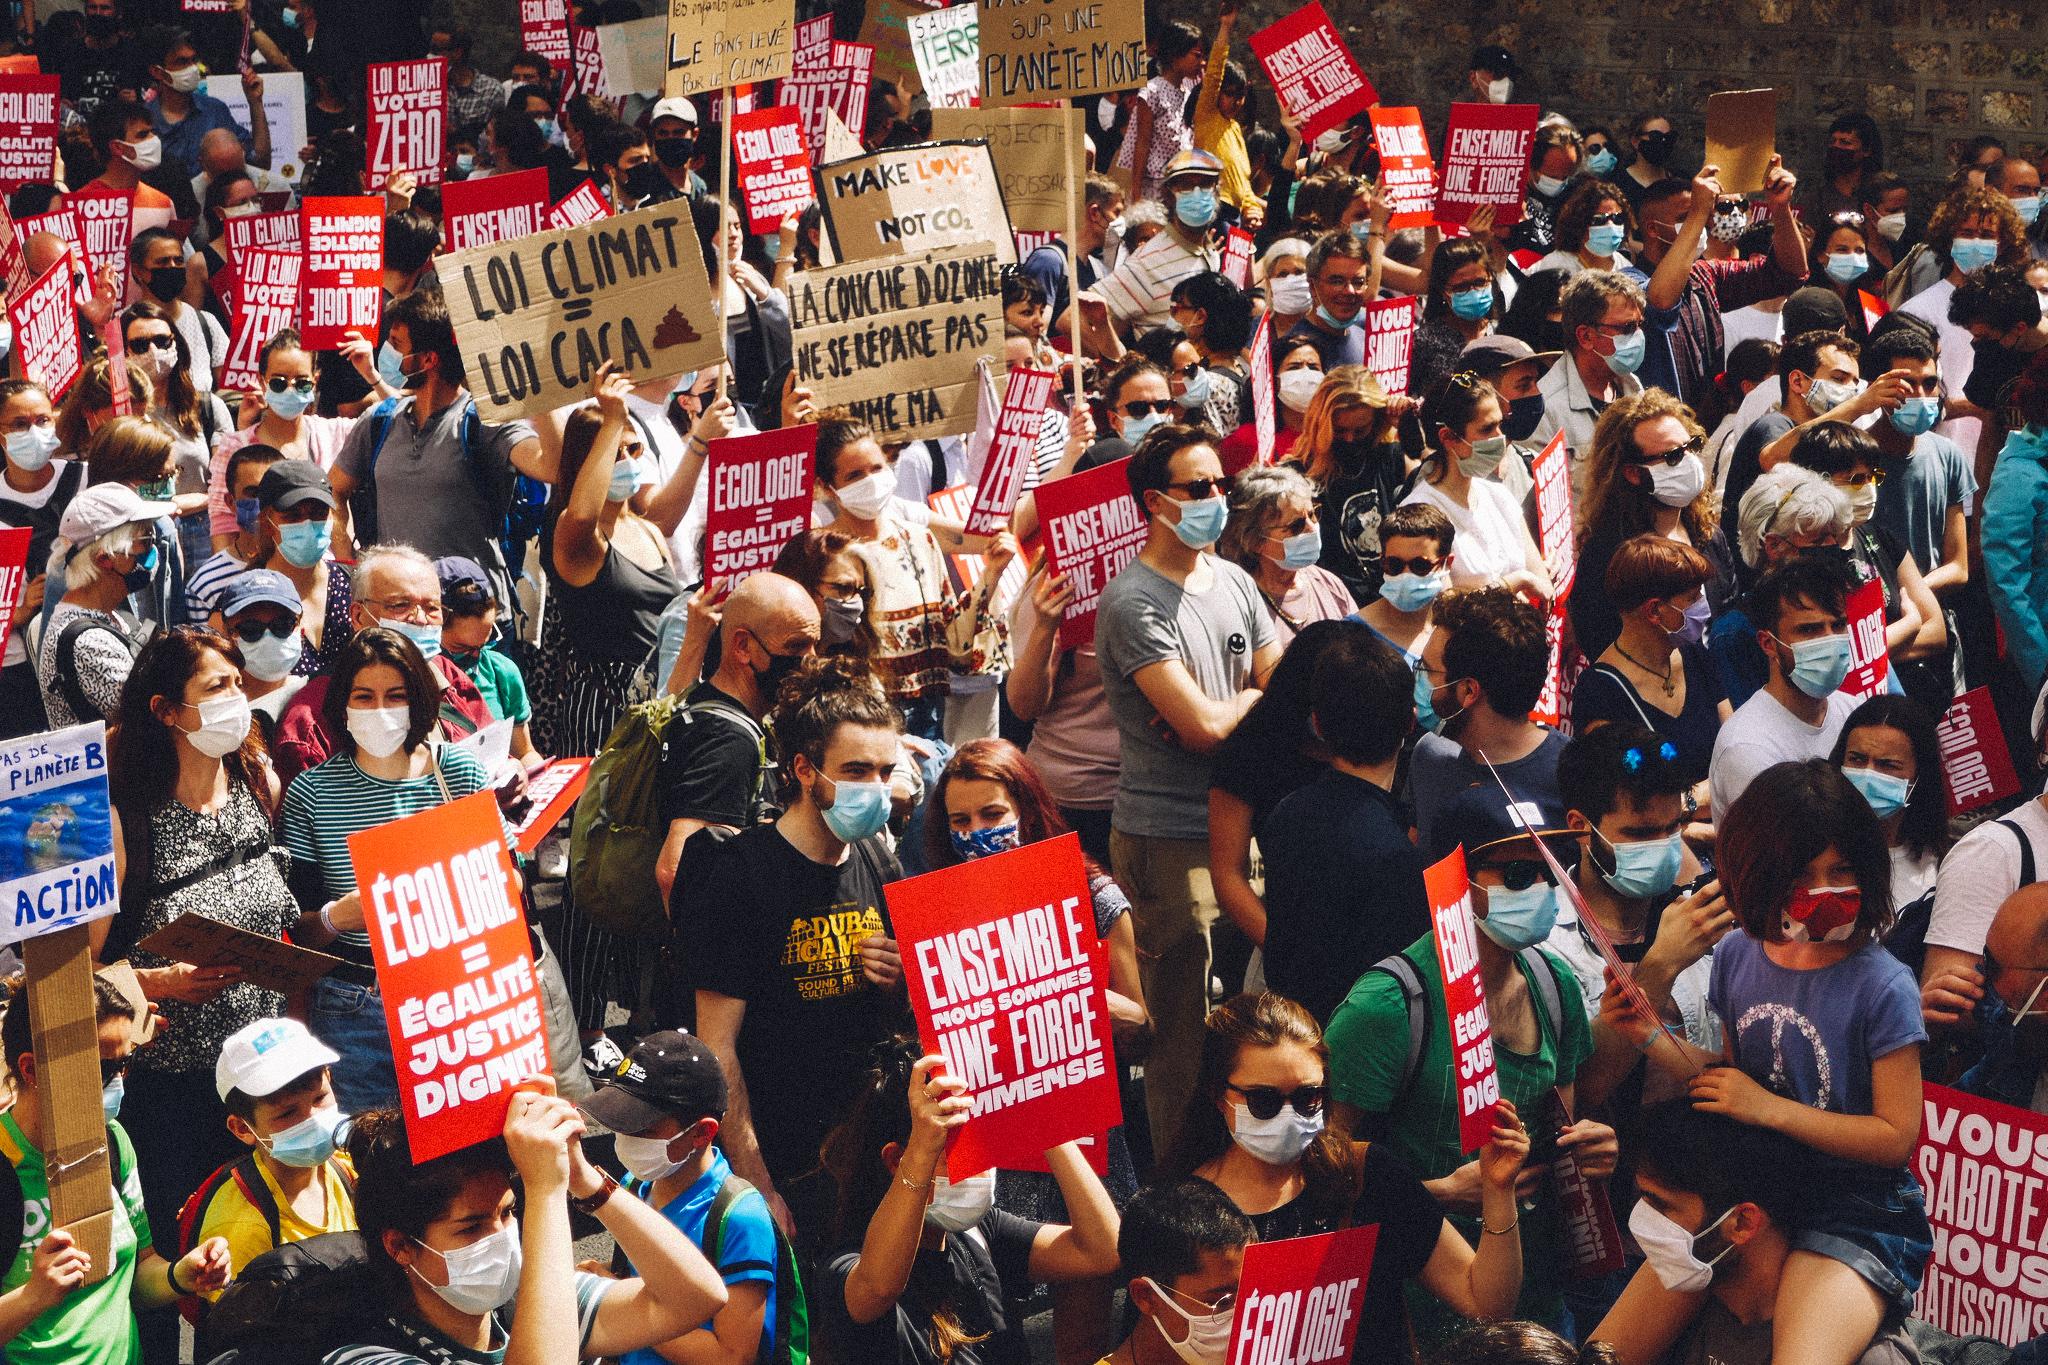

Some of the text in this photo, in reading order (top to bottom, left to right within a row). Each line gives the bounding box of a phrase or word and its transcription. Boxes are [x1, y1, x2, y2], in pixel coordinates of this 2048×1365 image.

[184, 0, 231, 11] POINT
[1011, 4, 1103, 40] SUR UNE
[729, 50, 787, 81] CLIMAT
[985, 42, 1089, 97] PLANÈTE
[1264, 25, 1339, 82] ENSEMBLE
[372, 62, 441, 94] LOI CLIMAT
[1309, 56, 1357, 98] FORCE
[0, 93, 55, 123] COLOGIE
[373, 90, 442, 112] VOTÉE
[0, 136, 53, 150] GALITÉ
[0, 152, 52, 164] USTICE
[373, 108, 441, 172] ZÉRO
[735, 123, 804, 164] ÉCOLOGIE
[1451, 128, 1530, 158] ENSEMBLE
[0, 166, 50, 179] IGNITÉ
[833, 162, 910, 198] MAKE
[1444, 165, 1523, 194] UNE FORCE
[1442, 192, 1519, 204] IMMENSE
[229, 213, 300, 248] LOI CLIMAT
[309, 215, 381, 235] DIGNITÉ
[876, 214, 926, 244] NOT
[309, 235, 380, 252] JUSTICE
[244, 252, 267, 283] LOI
[309, 253, 381, 272] ÉGALITÉ
[463, 217, 678, 321] LOI CLIMAT
[15, 262, 69, 327] VOUS
[243, 284, 297, 305] VOTÉE
[309, 287, 380, 328] ÉCOLOGIE
[789, 280, 820, 329] LA
[824, 264, 907, 324] COUCHE
[20, 282, 73, 364] SABOTEZ
[1369, 305, 1412, 332] VOUS
[478, 317, 651, 405] LOI CACA
[799, 313, 989, 382] NE SE RÉPARE PAS
[1367, 328, 1410, 373] SABOTEZ
[907, 387, 944, 427] MA
[715, 452, 808, 512] ÉCOLOGIE
[713, 515, 805, 551] ÉGALITÉ
[1049, 493, 1149, 559] ENSEMBL
[10, 742, 105, 791] PLANÈTE B
[28, 744, 48, 758] DE
[372, 840, 518, 966] ÉCOLOGIE
[811, 911, 861, 938] DUB
[915, 896, 1088, 1011] ENSEMBLE
[398, 955, 534, 1039] ÉGALITÉ
[798, 978, 838, 991] SOUND
[801, 987, 840, 999] CULTURE
[931, 966, 1092, 1031] NOUS SOMMES
[408, 996, 540, 1076] JUSTICE
[938, 986, 1102, 1092] UNE FORCE
[414, 1034, 548, 1119] DIGNITÉ
[1235, 1278, 1359, 1365] ÉCOLOGIE
